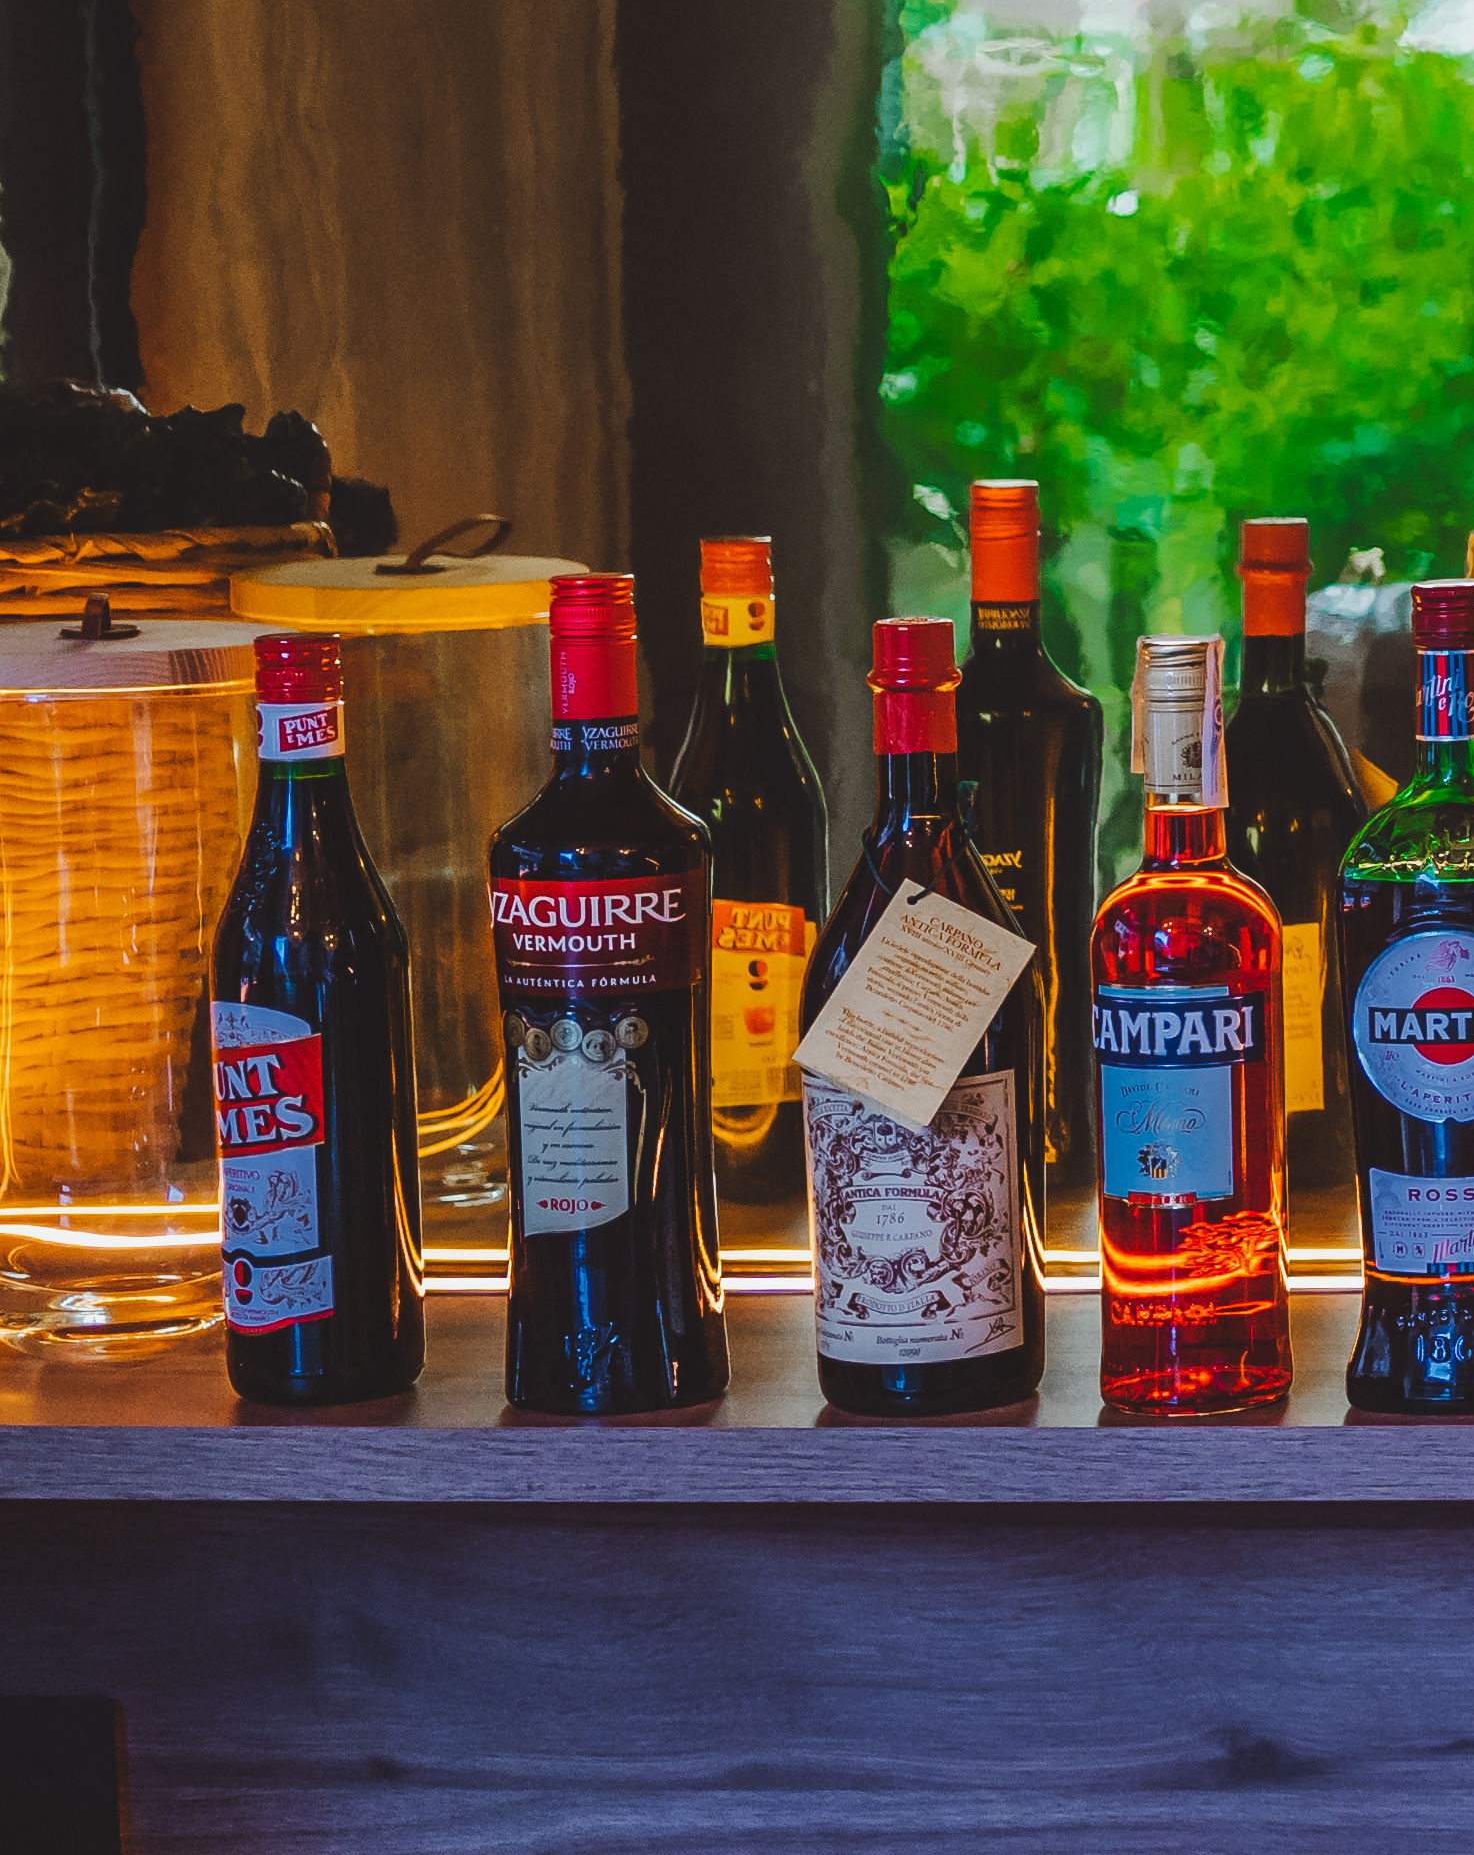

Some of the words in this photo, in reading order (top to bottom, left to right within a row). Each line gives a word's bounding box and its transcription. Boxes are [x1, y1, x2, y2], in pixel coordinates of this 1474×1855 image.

[284, 713, 327, 733] PUNT
[296, 727, 335, 746] MES
[899, 912, 947, 942] ANTICA
[944, 935, 1003, 971] FORMULA
[928, 915, 984, 950] CARPANO
[512, 932, 636, 953] VERMOUTH
[504, 974, 513, 984] LA
[516, 976, 585, 988] AUTÉNTICA
[591, 974, 657, 988] FÓRMULA
[1093, 1003, 1254, 1056] CAMPARI
[844, 1187, 881, 1199] ANTICA
[884, 1187, 940, 1200] FORMULA
[550, 1197, 589, 1215] ROJO
[876, 1211, 905, 1227] 1786
